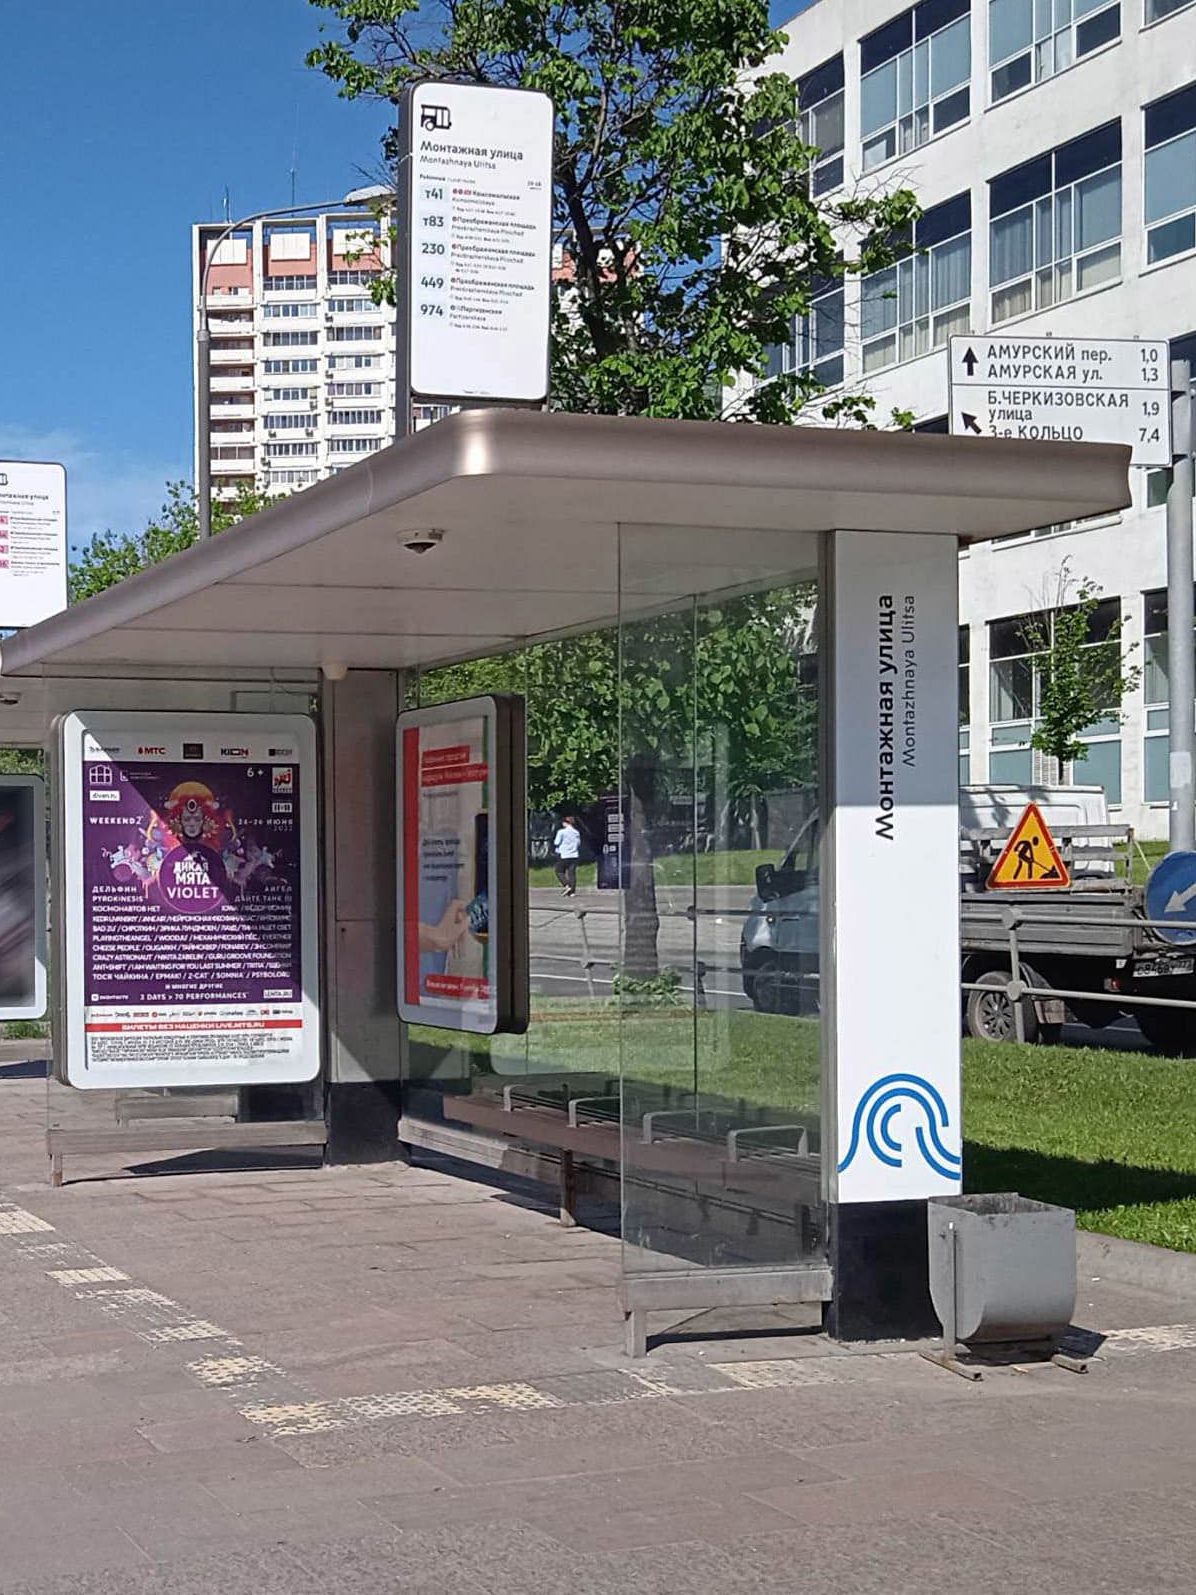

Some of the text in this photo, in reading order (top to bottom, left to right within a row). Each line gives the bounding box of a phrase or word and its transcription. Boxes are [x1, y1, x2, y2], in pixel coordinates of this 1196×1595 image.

[420, 140, 523, 160] Монтажная улица
[420, 155, 472, 168] Montazhnaya
[422, 242, 445, 255] 230
[421, 276, 444, 289] 449
[420, 304, 443, 317] 974
[987, 343, 1112, 364] АМУРСКИЙ пер.
[1141, 348, 1158, 364] 1,0
[987, 364, 1103, 383] АМУРСКАЯ ул.
[1141, 367, 1159, 383] 1,3
[988, 408, 1033, 423] улица
[1142, 401, 1160, 417] 1,9
[1018, 426, 1083, 441] КОЛЬЦО
[1139, 428, 1160, 444] 7,4
[902, 595, 918, 767] Montazhnaya Ulitsa
[875, 595, 898, 840] Монтажная улица
[145, 747, 166, 755] МТС
[173, 861, 209, 873] ДИКАЯ
[175, 872, 211, 885] МЯТА
[167, 887, 219, 898] VIOLET
